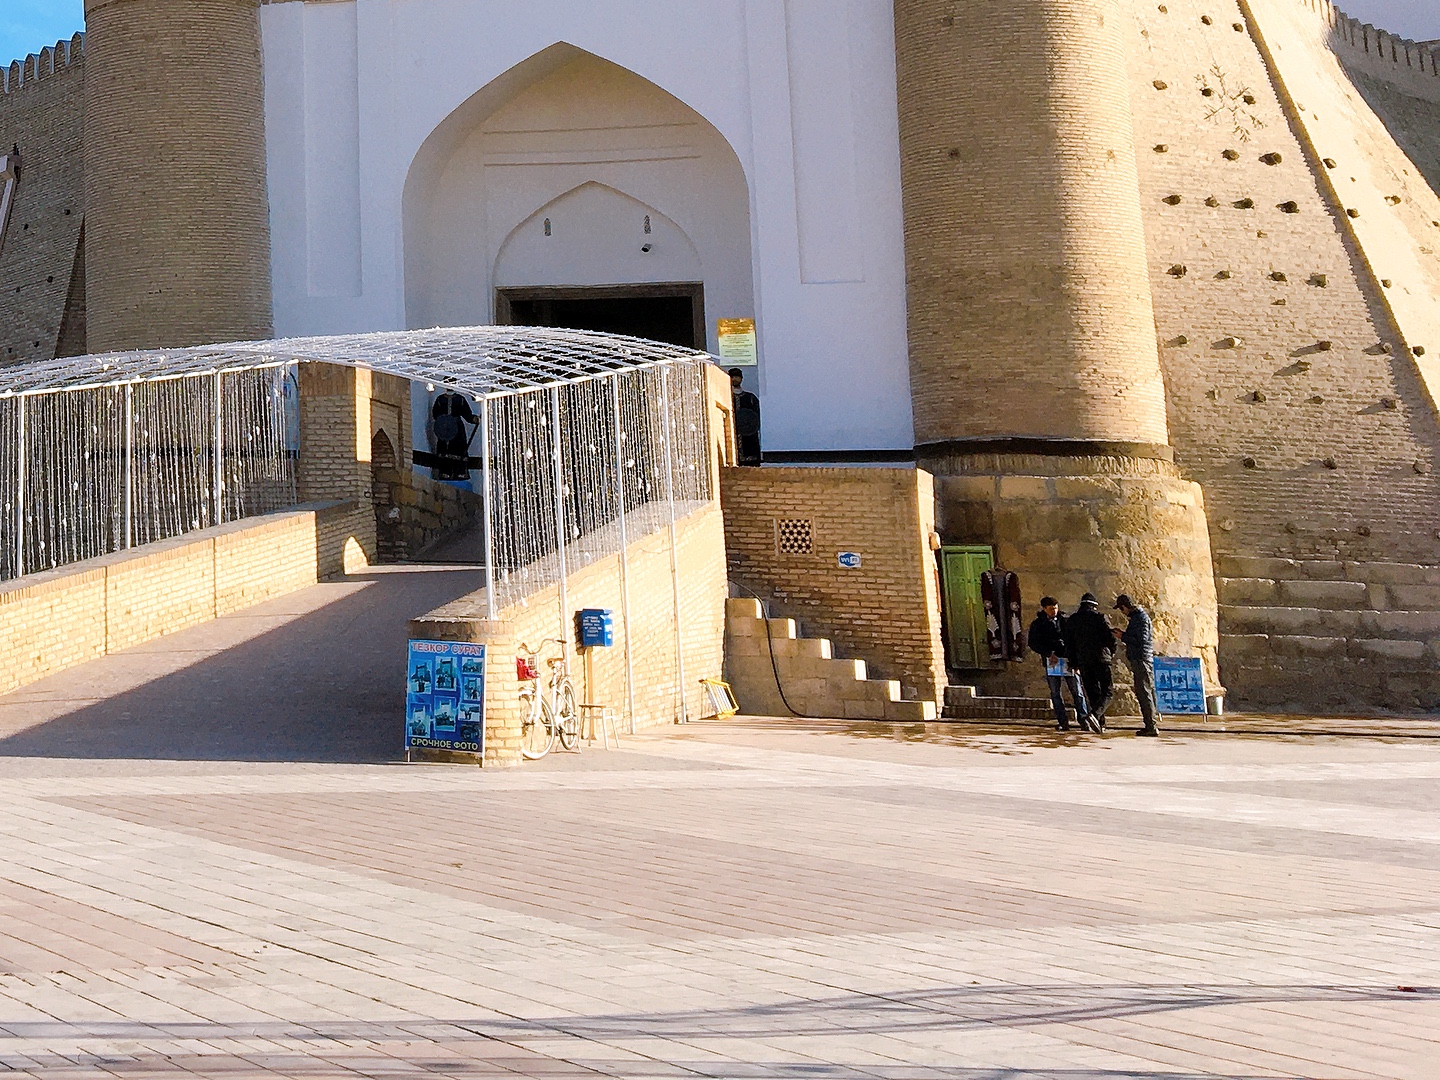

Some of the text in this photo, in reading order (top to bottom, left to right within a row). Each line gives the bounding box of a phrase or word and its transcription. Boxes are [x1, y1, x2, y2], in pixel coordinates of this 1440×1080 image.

[412, 642, 483, 656] ТЕЗКОР СУРАТ
[411, 738, 478, 750] СРОЧНОЕ ФОТО
